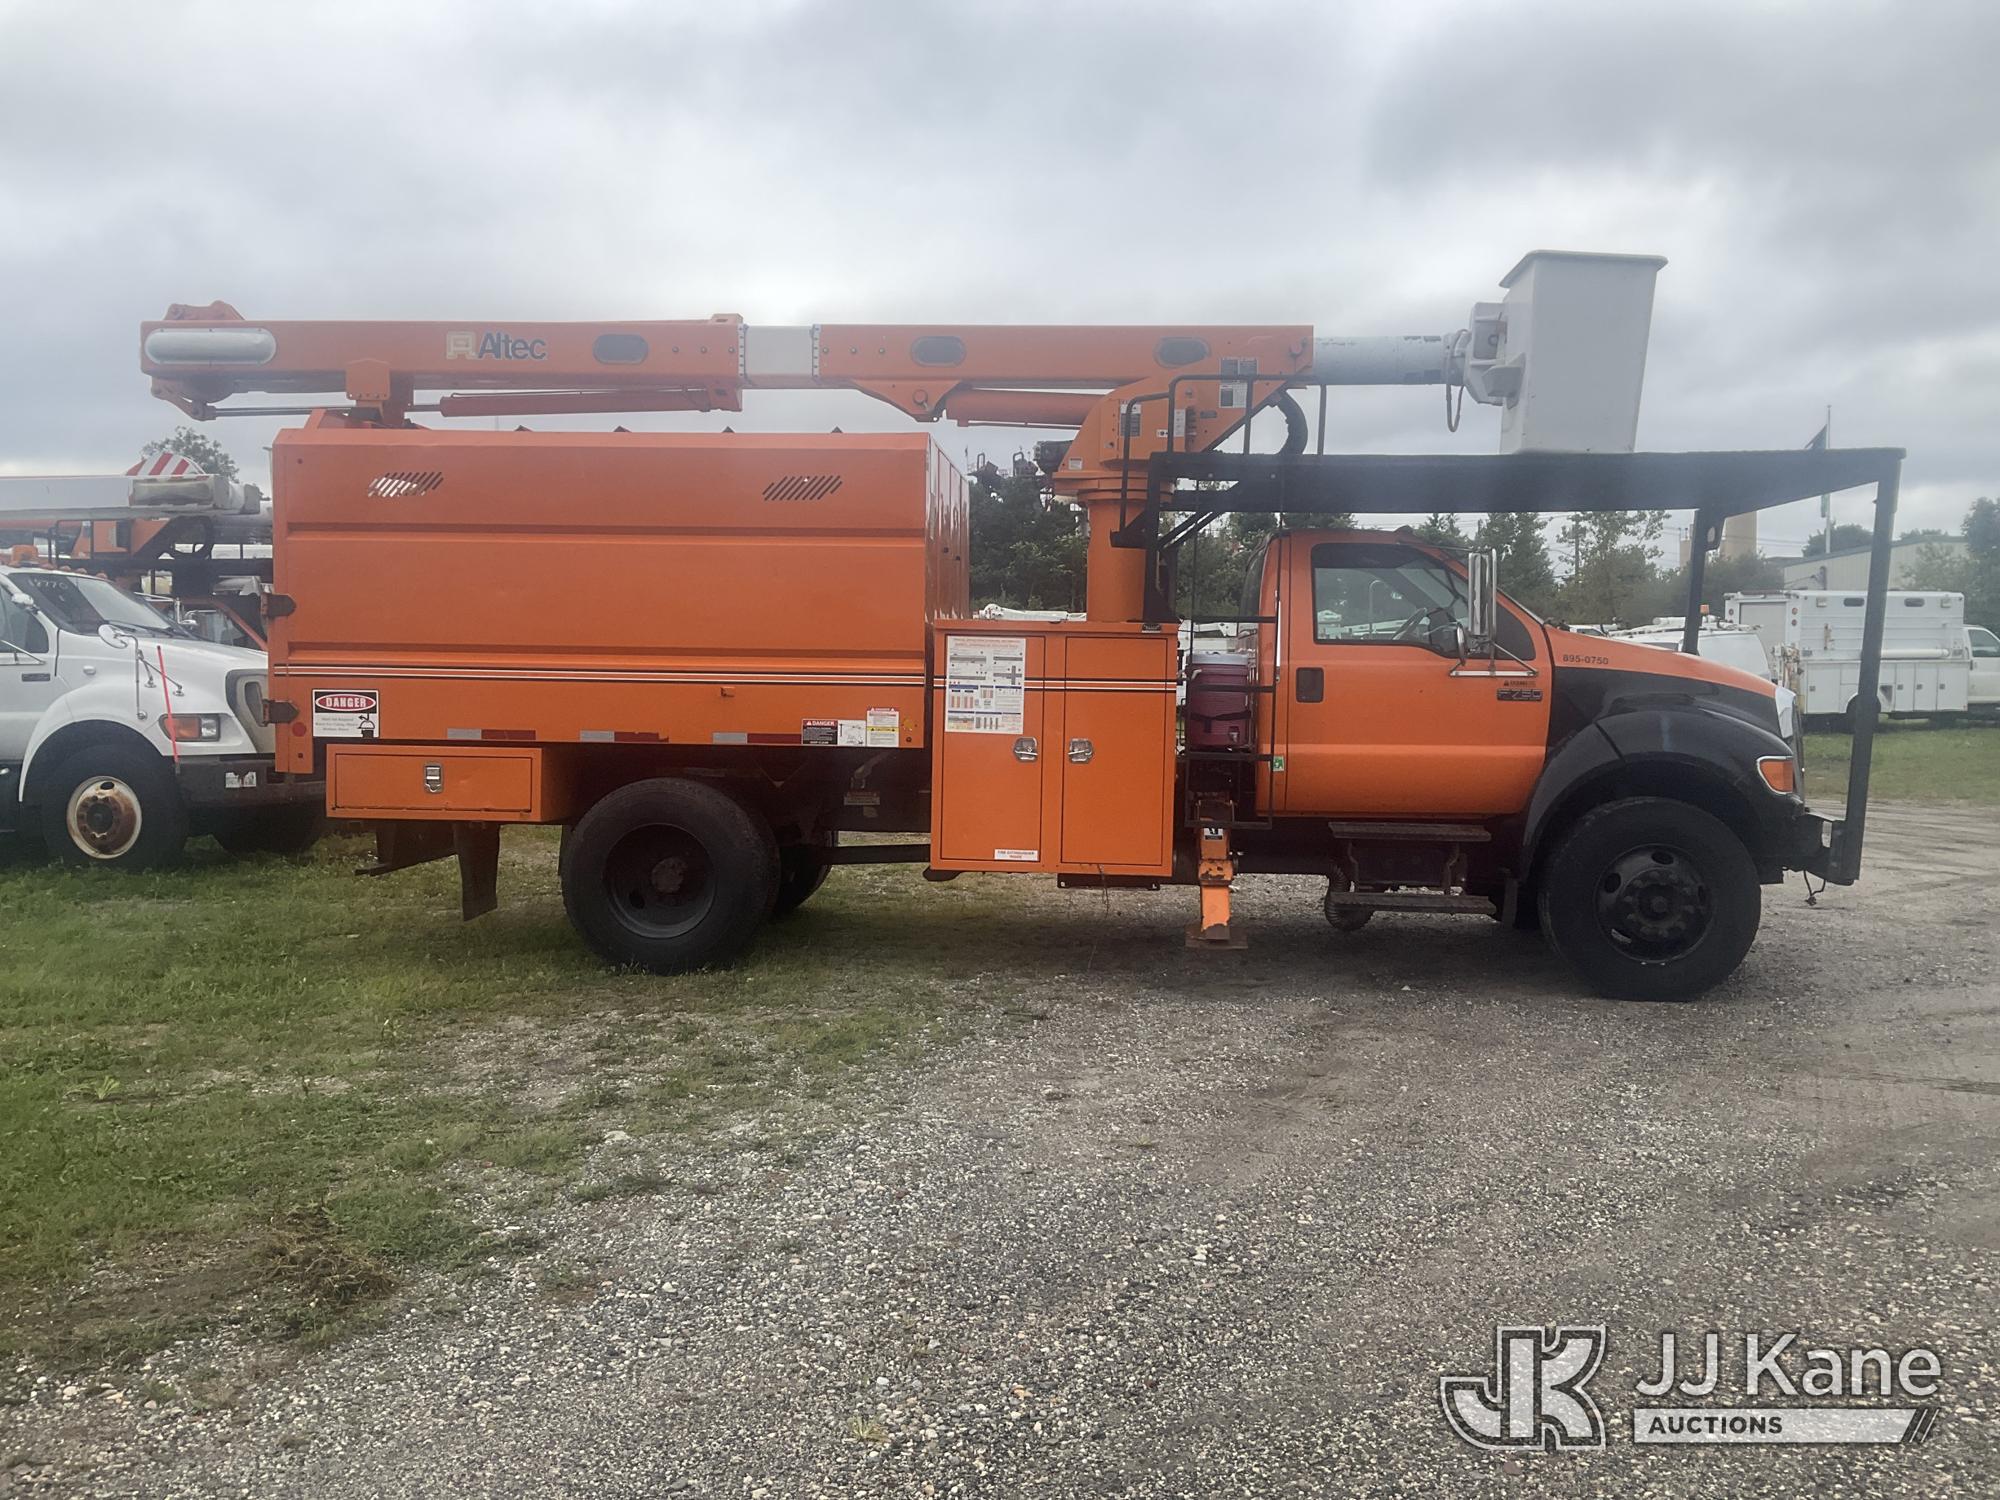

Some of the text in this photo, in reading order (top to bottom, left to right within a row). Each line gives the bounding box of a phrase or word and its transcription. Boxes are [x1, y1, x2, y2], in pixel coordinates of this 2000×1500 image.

[478, 332, 546, 360] Altec
[1562, 654, 1609, 665] 895-0750
[326, 697, 366, 708] DANGER
